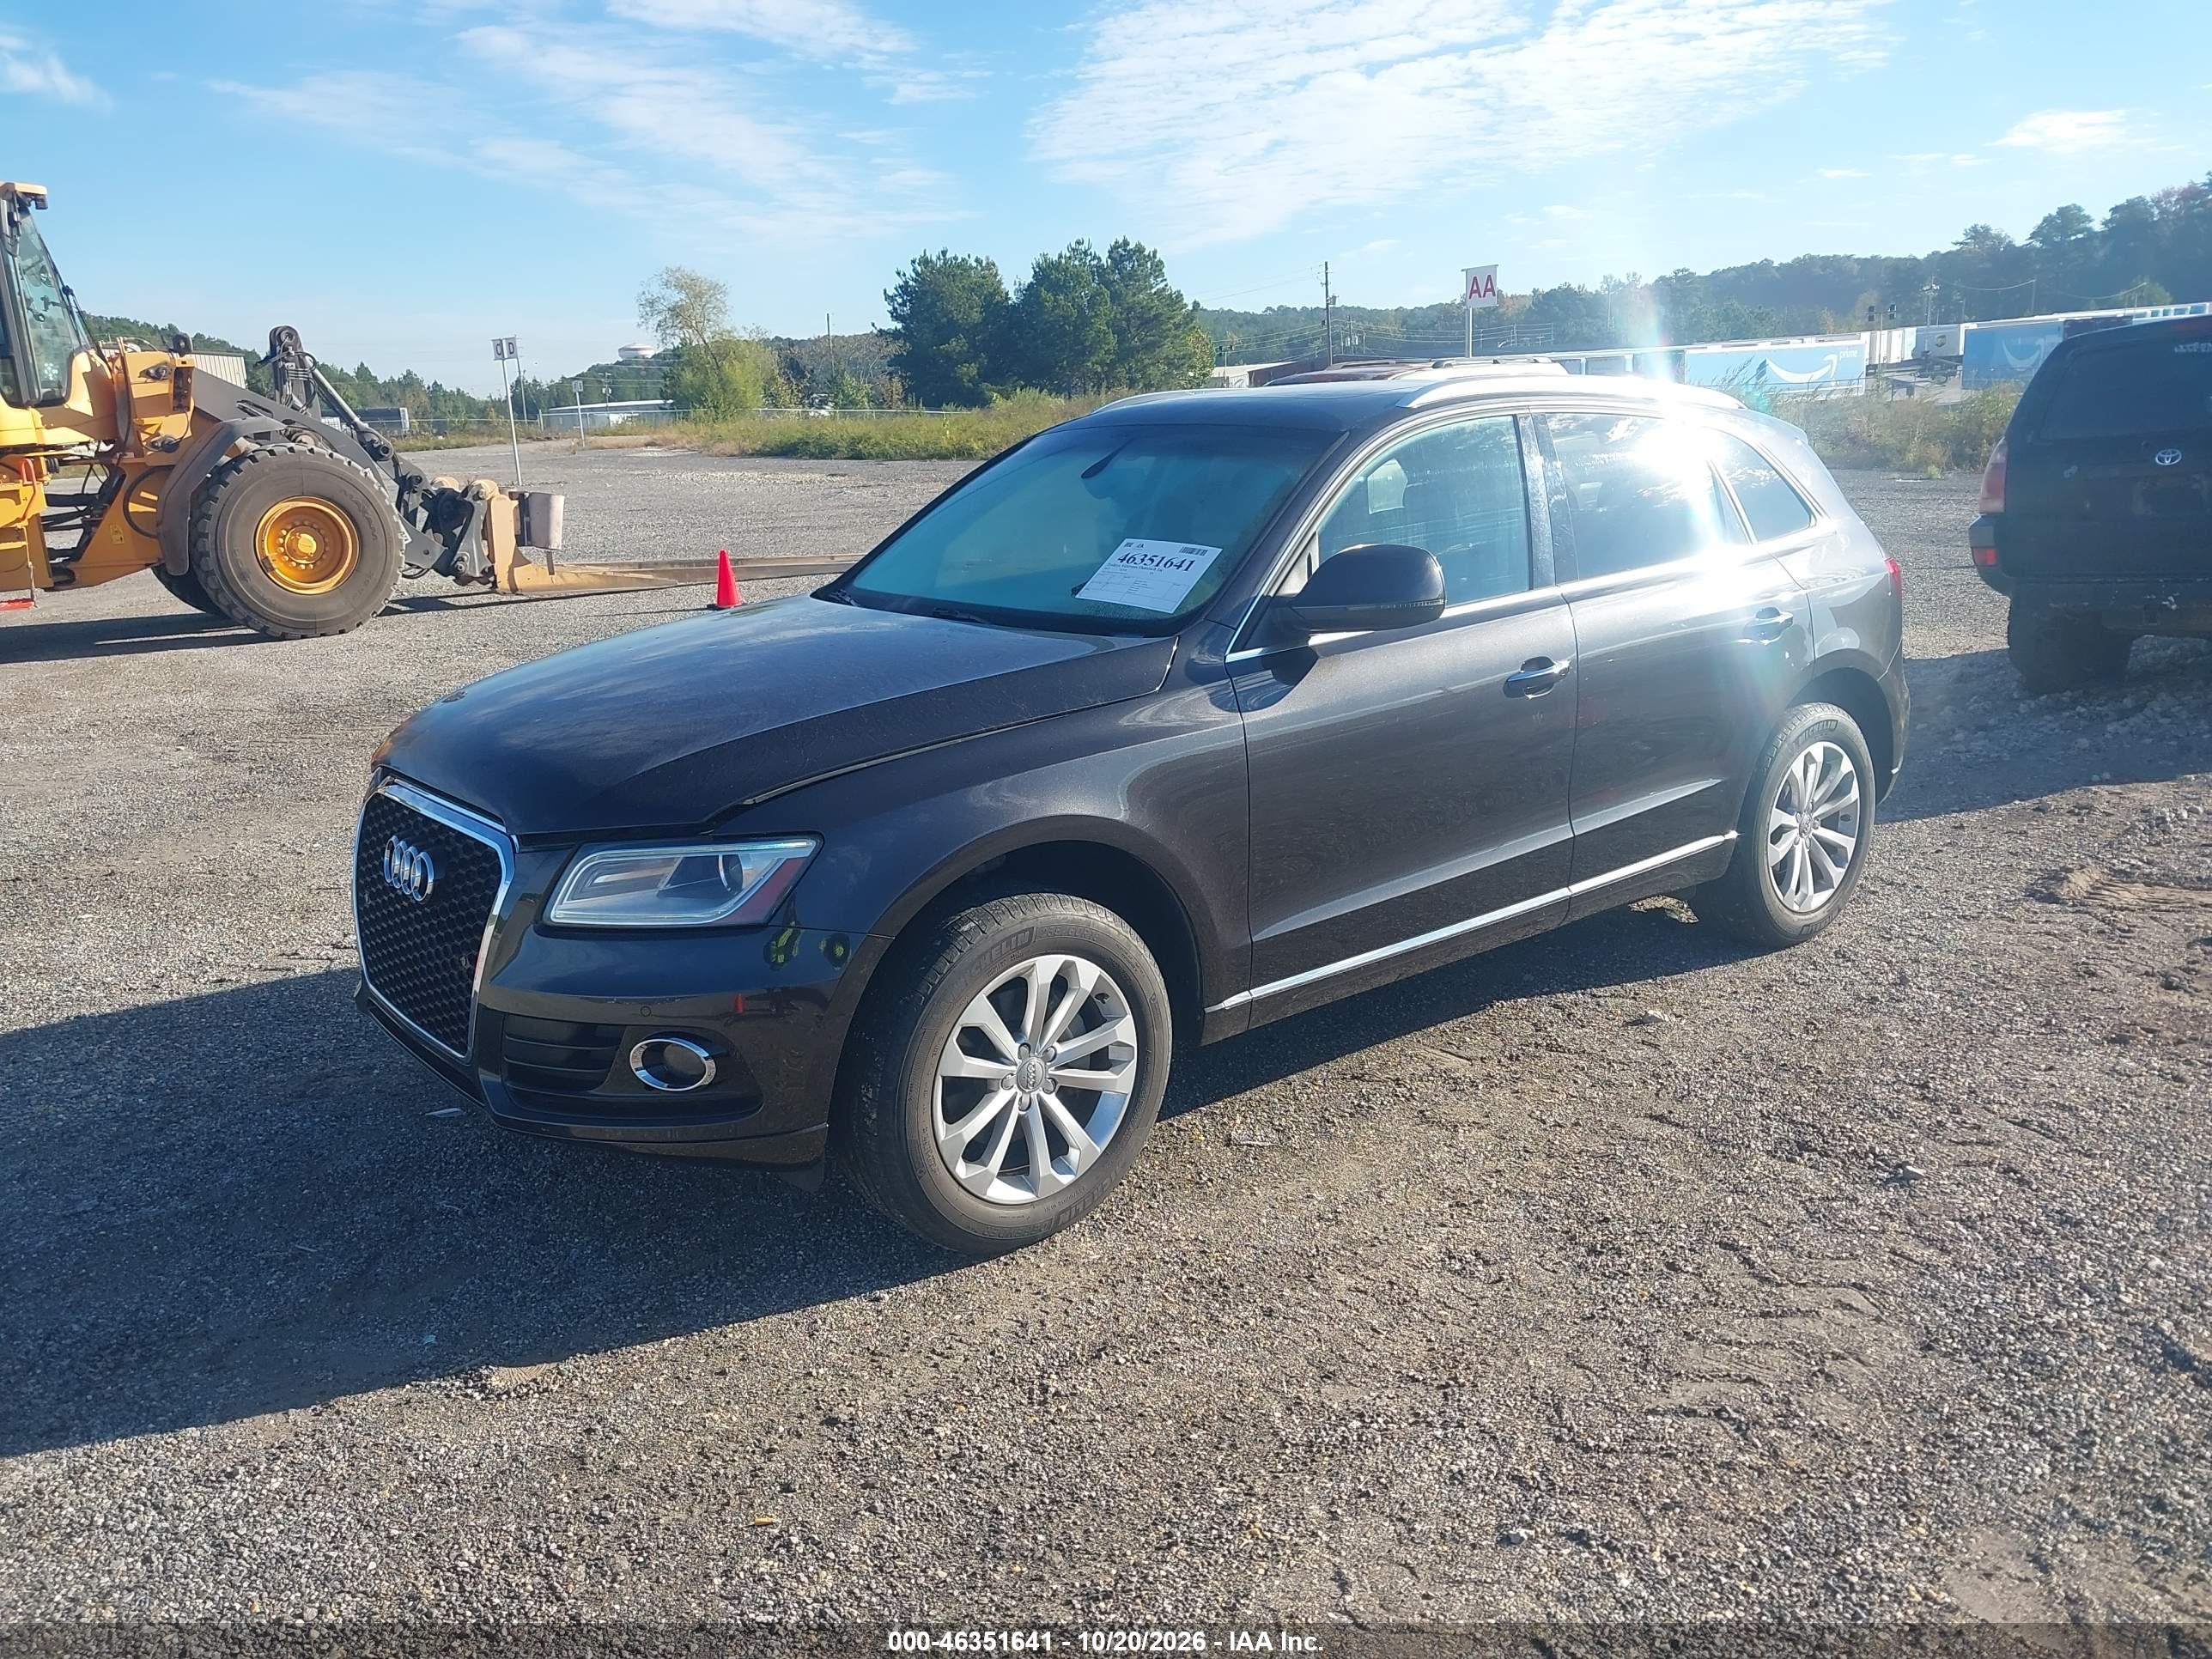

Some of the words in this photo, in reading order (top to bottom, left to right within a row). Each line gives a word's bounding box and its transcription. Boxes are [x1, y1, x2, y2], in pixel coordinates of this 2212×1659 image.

[1468, 274, 1497, 300] AA
[507, 341, 515, 355] D
[1839, 347, 1858, 361] prime
[1116, 552, 1196, 573] 46351641
